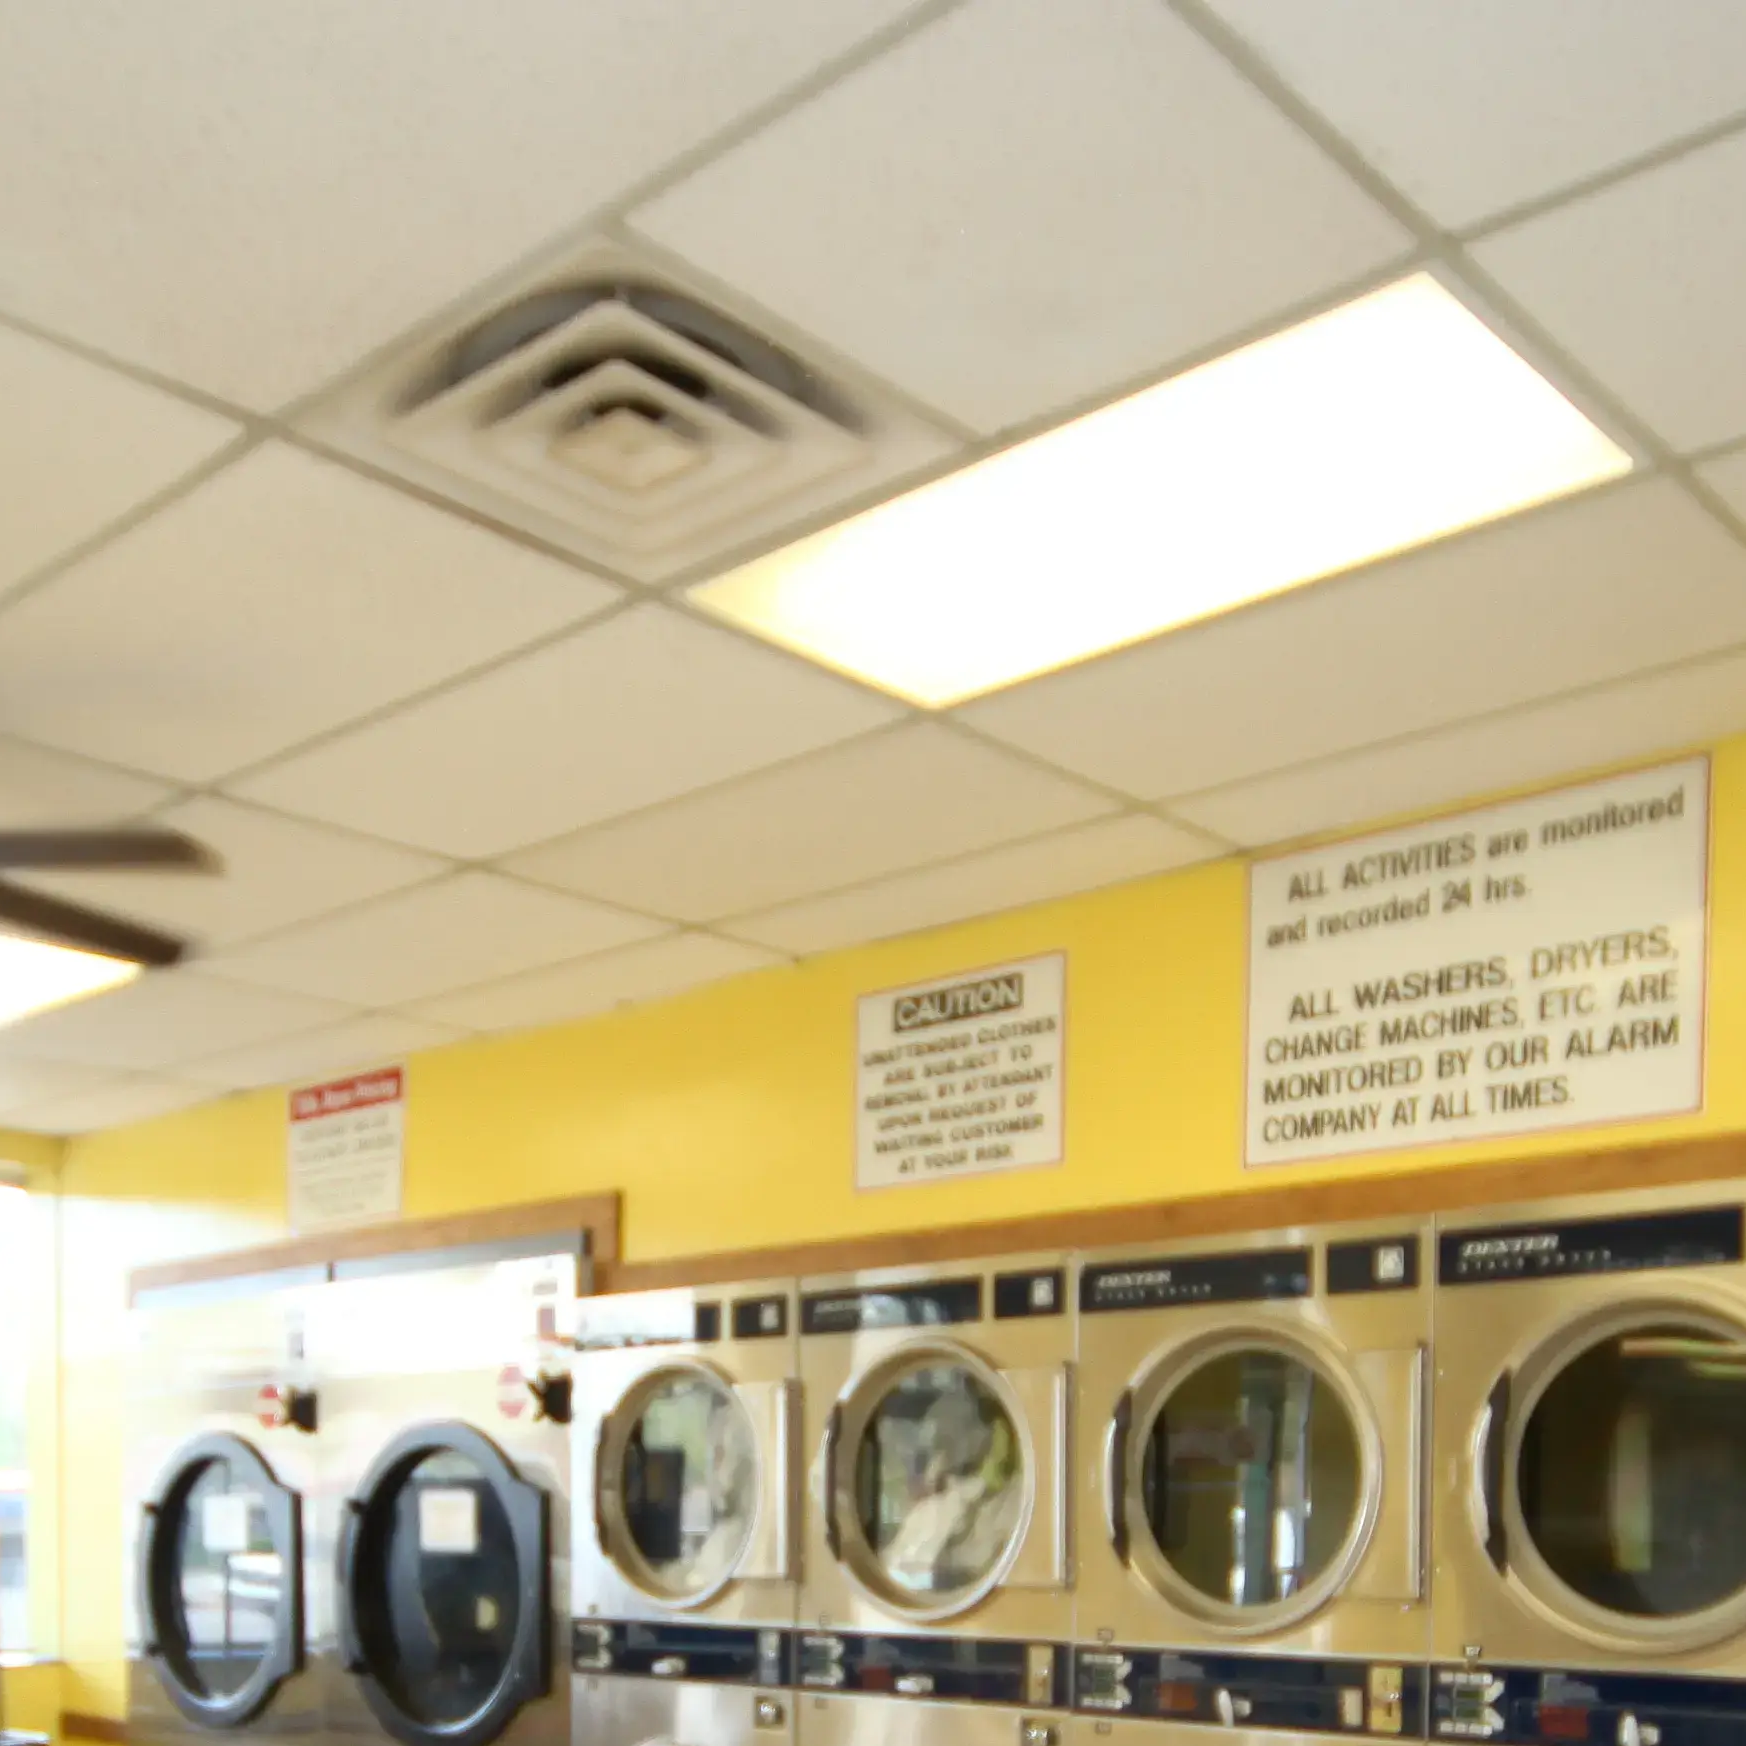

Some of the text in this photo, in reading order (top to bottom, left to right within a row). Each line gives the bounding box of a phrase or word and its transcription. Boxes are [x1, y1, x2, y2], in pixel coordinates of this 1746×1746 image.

[1288, 785, 1684, 903] ALL ACTIVITIES are monitored
[1266, 873, 1533, 948] and recorded 24 hrs.
[897, 978, 1019, 1026] CAUTION
[1289, 925, 1679, 1022] ALL WASHERS, DRYERS,
[1265, 1023, 1366, 1064] CHANGE
[1380, 999, 1524, 1045] MACHINES,
[1617, 969, 1678, 1009] ARE
[962, 1064, 1053, 1093] ATTENDANT
[1010, 1045, 1033, 1062] TO
[1263, 1015, 1680, 1104] MONITORED BY OUR ALARM
[1016, 1091, 1037, 1108] OF
[1263, 1076, 1574, 1144] COMPANY AT ALL TIMES.
[899, 1156, 915, 1173] AT
